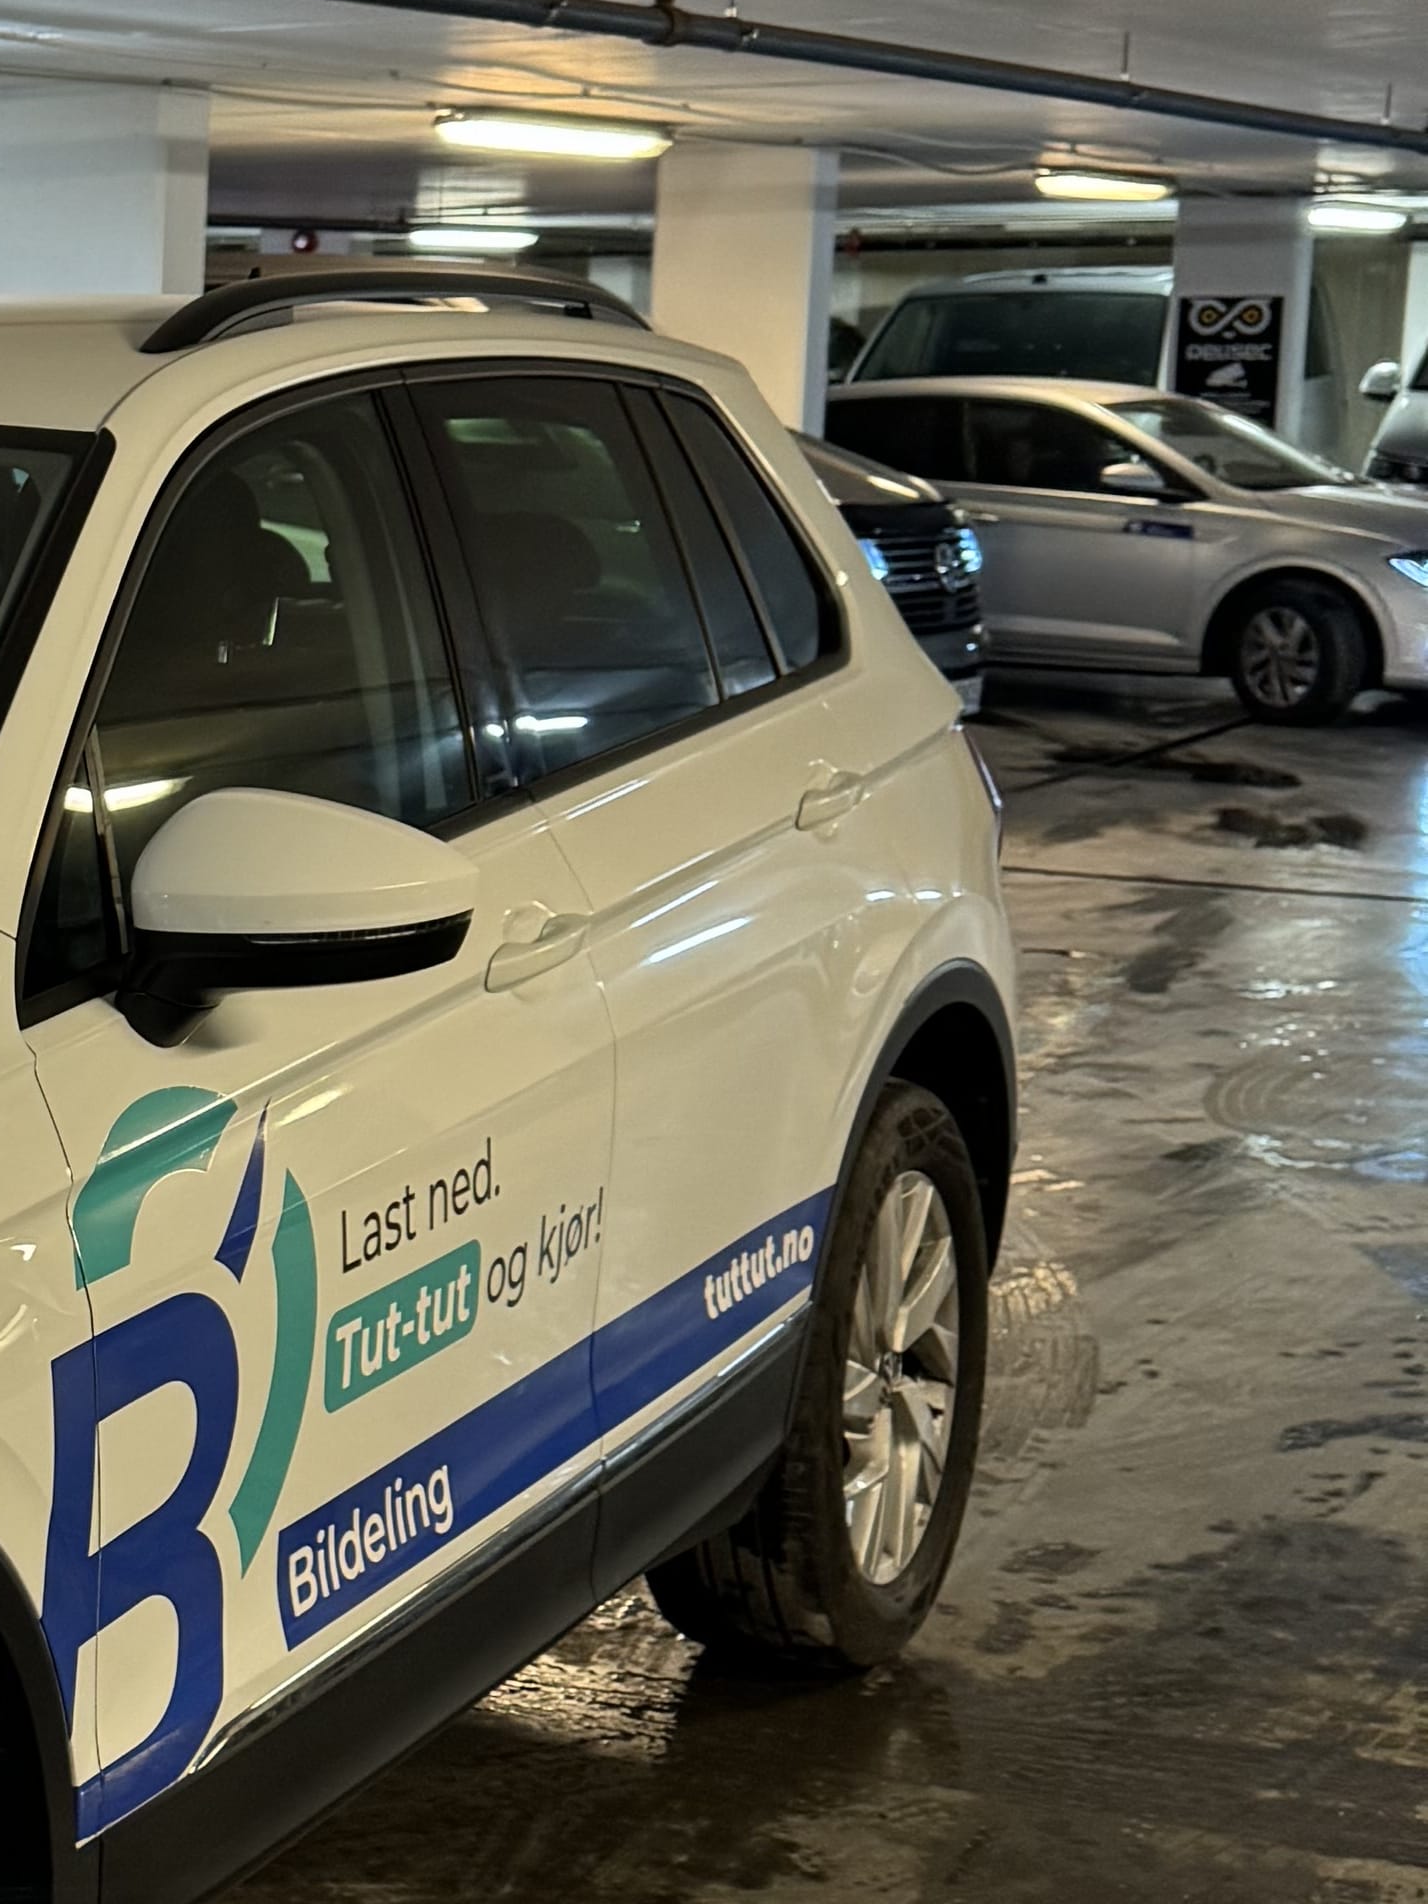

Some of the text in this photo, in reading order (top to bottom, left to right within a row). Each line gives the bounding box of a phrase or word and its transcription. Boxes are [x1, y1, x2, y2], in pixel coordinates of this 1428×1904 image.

[342, 1136, 500, 1274] Last ned.
[704, 1224, 814, 1319] tuttut.no
[336, 1186, 603, 1389] Tut-tut og kjør!
[288, 1464, 454, 1617] Bildeling
